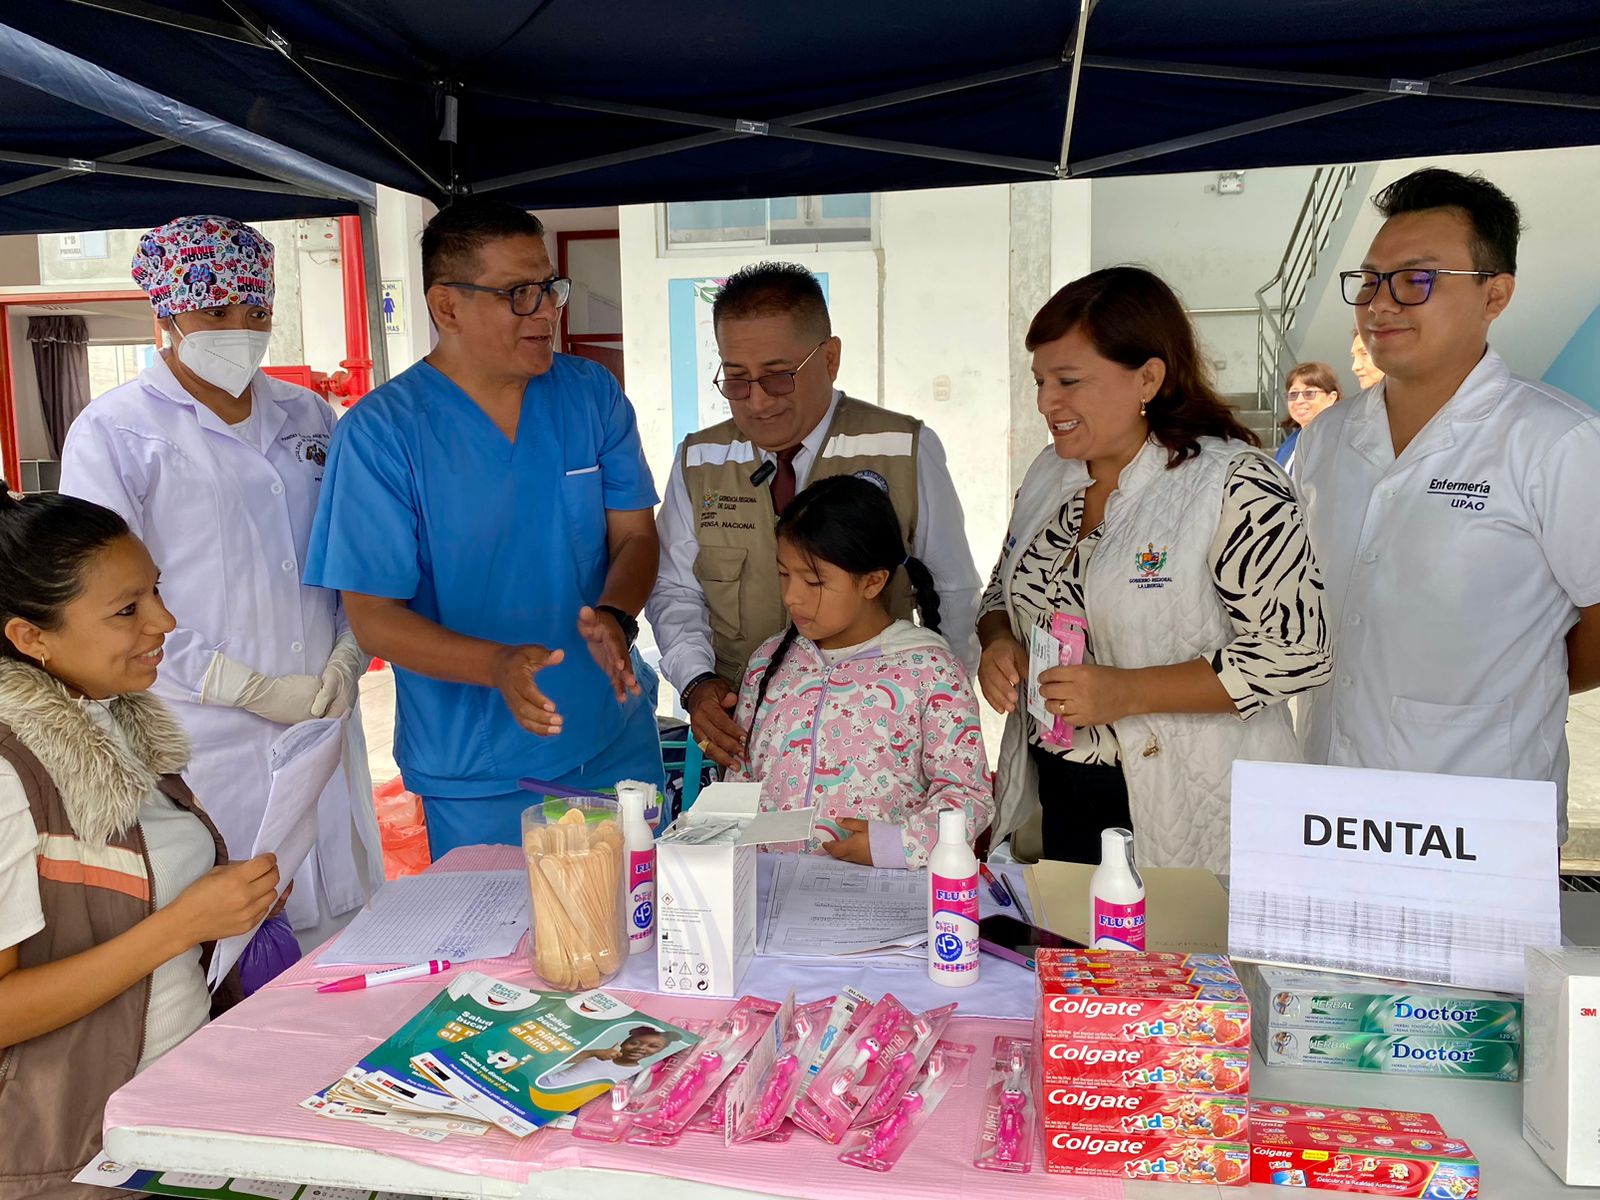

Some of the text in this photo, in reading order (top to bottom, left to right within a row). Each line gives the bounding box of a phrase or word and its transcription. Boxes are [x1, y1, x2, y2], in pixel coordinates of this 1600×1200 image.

[179, 245, 215, 256] MINNIE
[181, 251, 216, 264] MOUSE
[237, 275, 267, 288] MINNIE
[237, 284, 266, 295] MOUSE
[1429, 478, 1491, 494] Enfermería
[1450, 499, 1485, 511] UPAO
[721, 521, 757, 530] NACIONAL
[1303, 813, 1477, 862] DENTAL
[635, 902, 652, 921] 45
[937, 934, 958, 954] 45
[1049, 997, 1143, 1018] Colgate
[1312, 999, 1355, 1010] HERBAL
[1394, 1002, 1478, 1023] Doctor
[1580, 1008, 1598, 1017] 3M
[449, 1022, 463, 1033] la
[456, 1015, 488, 1031] bucal
[461, 1010, 494, 1027] Salud
[544, 1012, 572, 1031] Salud
[440, 1030, 457, 1040] el
[511, 1026, 549, 1052] el niño
[523, 1020, 570, 1053] la niña y
[536, 1015, 582, 1047] bucal para
[1122, 1018, 1178, 1041] Kids
[1048, 1043, 1142, 1065] Colgate
[1309, 1039, 1352, 1050] HERBAL
[1391, 1043, 1475, 1063] Doctor
[1122, 1066, 1177, 1088] Kids
[1048, 1089, 1141, 1111] Colgate
[1121, 1113, 1176, 1133] Kids
[1052, 1133, 1144, 1155] Colgate
[1253, 1147, 1293, 1158] Colgate
[1123, 1157, 1179, 1179] Kids
[1269, 1160, 1293, 1170] Kids
